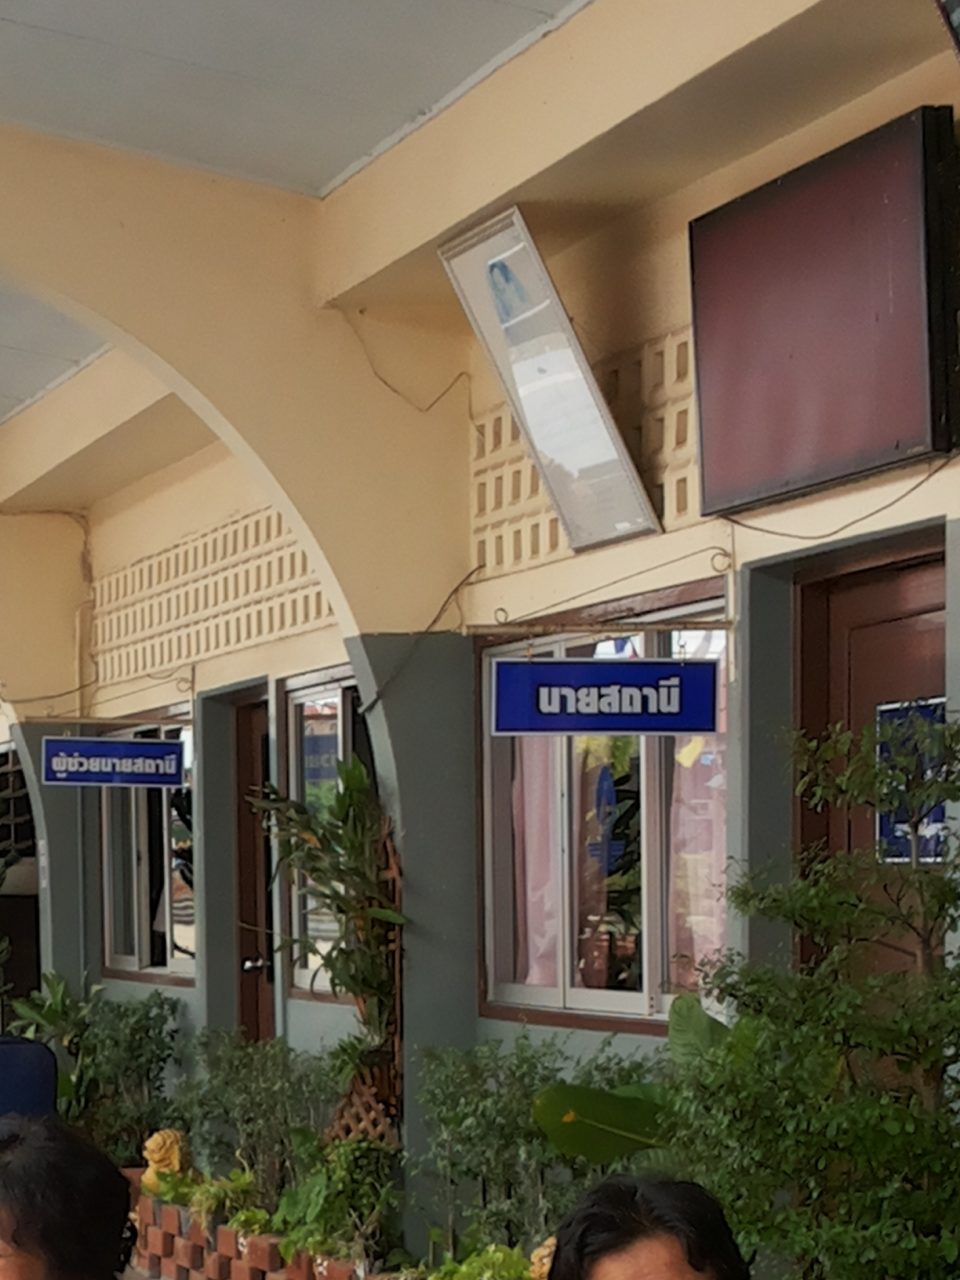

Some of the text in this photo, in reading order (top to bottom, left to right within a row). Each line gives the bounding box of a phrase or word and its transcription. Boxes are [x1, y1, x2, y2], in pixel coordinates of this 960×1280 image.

[538, 677, 681, 715] นายสถานี
[51, 751, 177, 779] ผู้ช่วยนายสถานี
